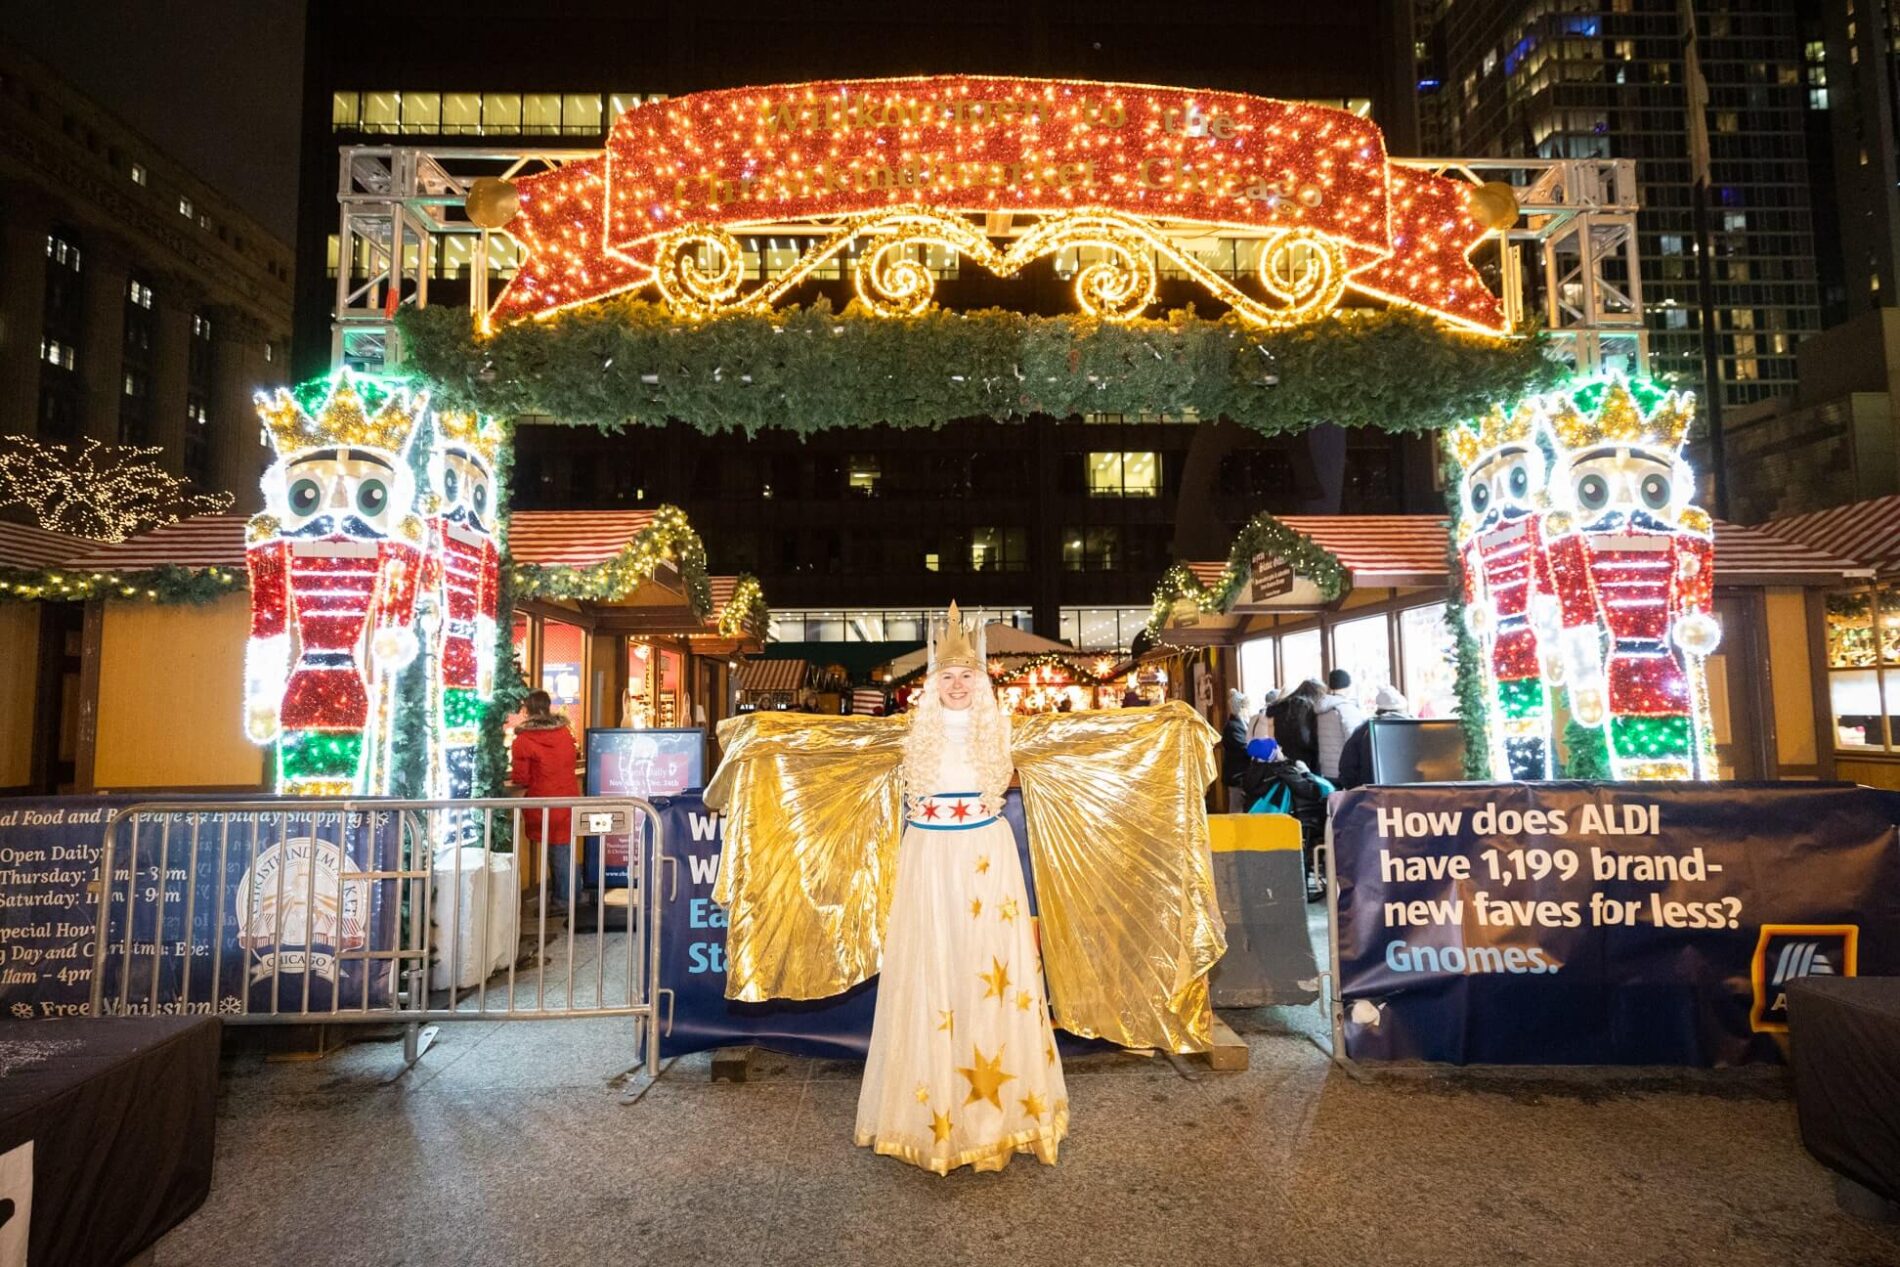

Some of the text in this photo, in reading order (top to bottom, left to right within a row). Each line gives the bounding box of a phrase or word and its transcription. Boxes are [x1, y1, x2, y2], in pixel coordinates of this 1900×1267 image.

[1084, 98, 1125, 128] to
[1162, 103, 1237, 139] the
[1139, 156, 1323, 214] Chicago
[23, 809, 64, 826] Food
[68, 808, 101, 824] and
[1377, 803, 1660, 837] How does ALDI
[1, 845, 104, 867] Open Daily:
[1380, 847, 1723, 887] have 1,199 brand-
[0, 867, 86, 888] Thursday:
[0, 890, 79, 909] Saturday:
[145, 887, 181, 904] 9m
[1384, 891, 1742, 929] new faves for less?
[56, 922, 115, 938] Hour:
[12, 945, 42, 965] Day
[45, 943, 77, 960] and
[266, 954, 327, 967] CICAO
[1386, 940, 1559, 974] Gnomes.
[2, 968, 37, 985] 11am
[57, 966, 93, 986] 4pm
[40, 996, 212, 1017] Free Admision
